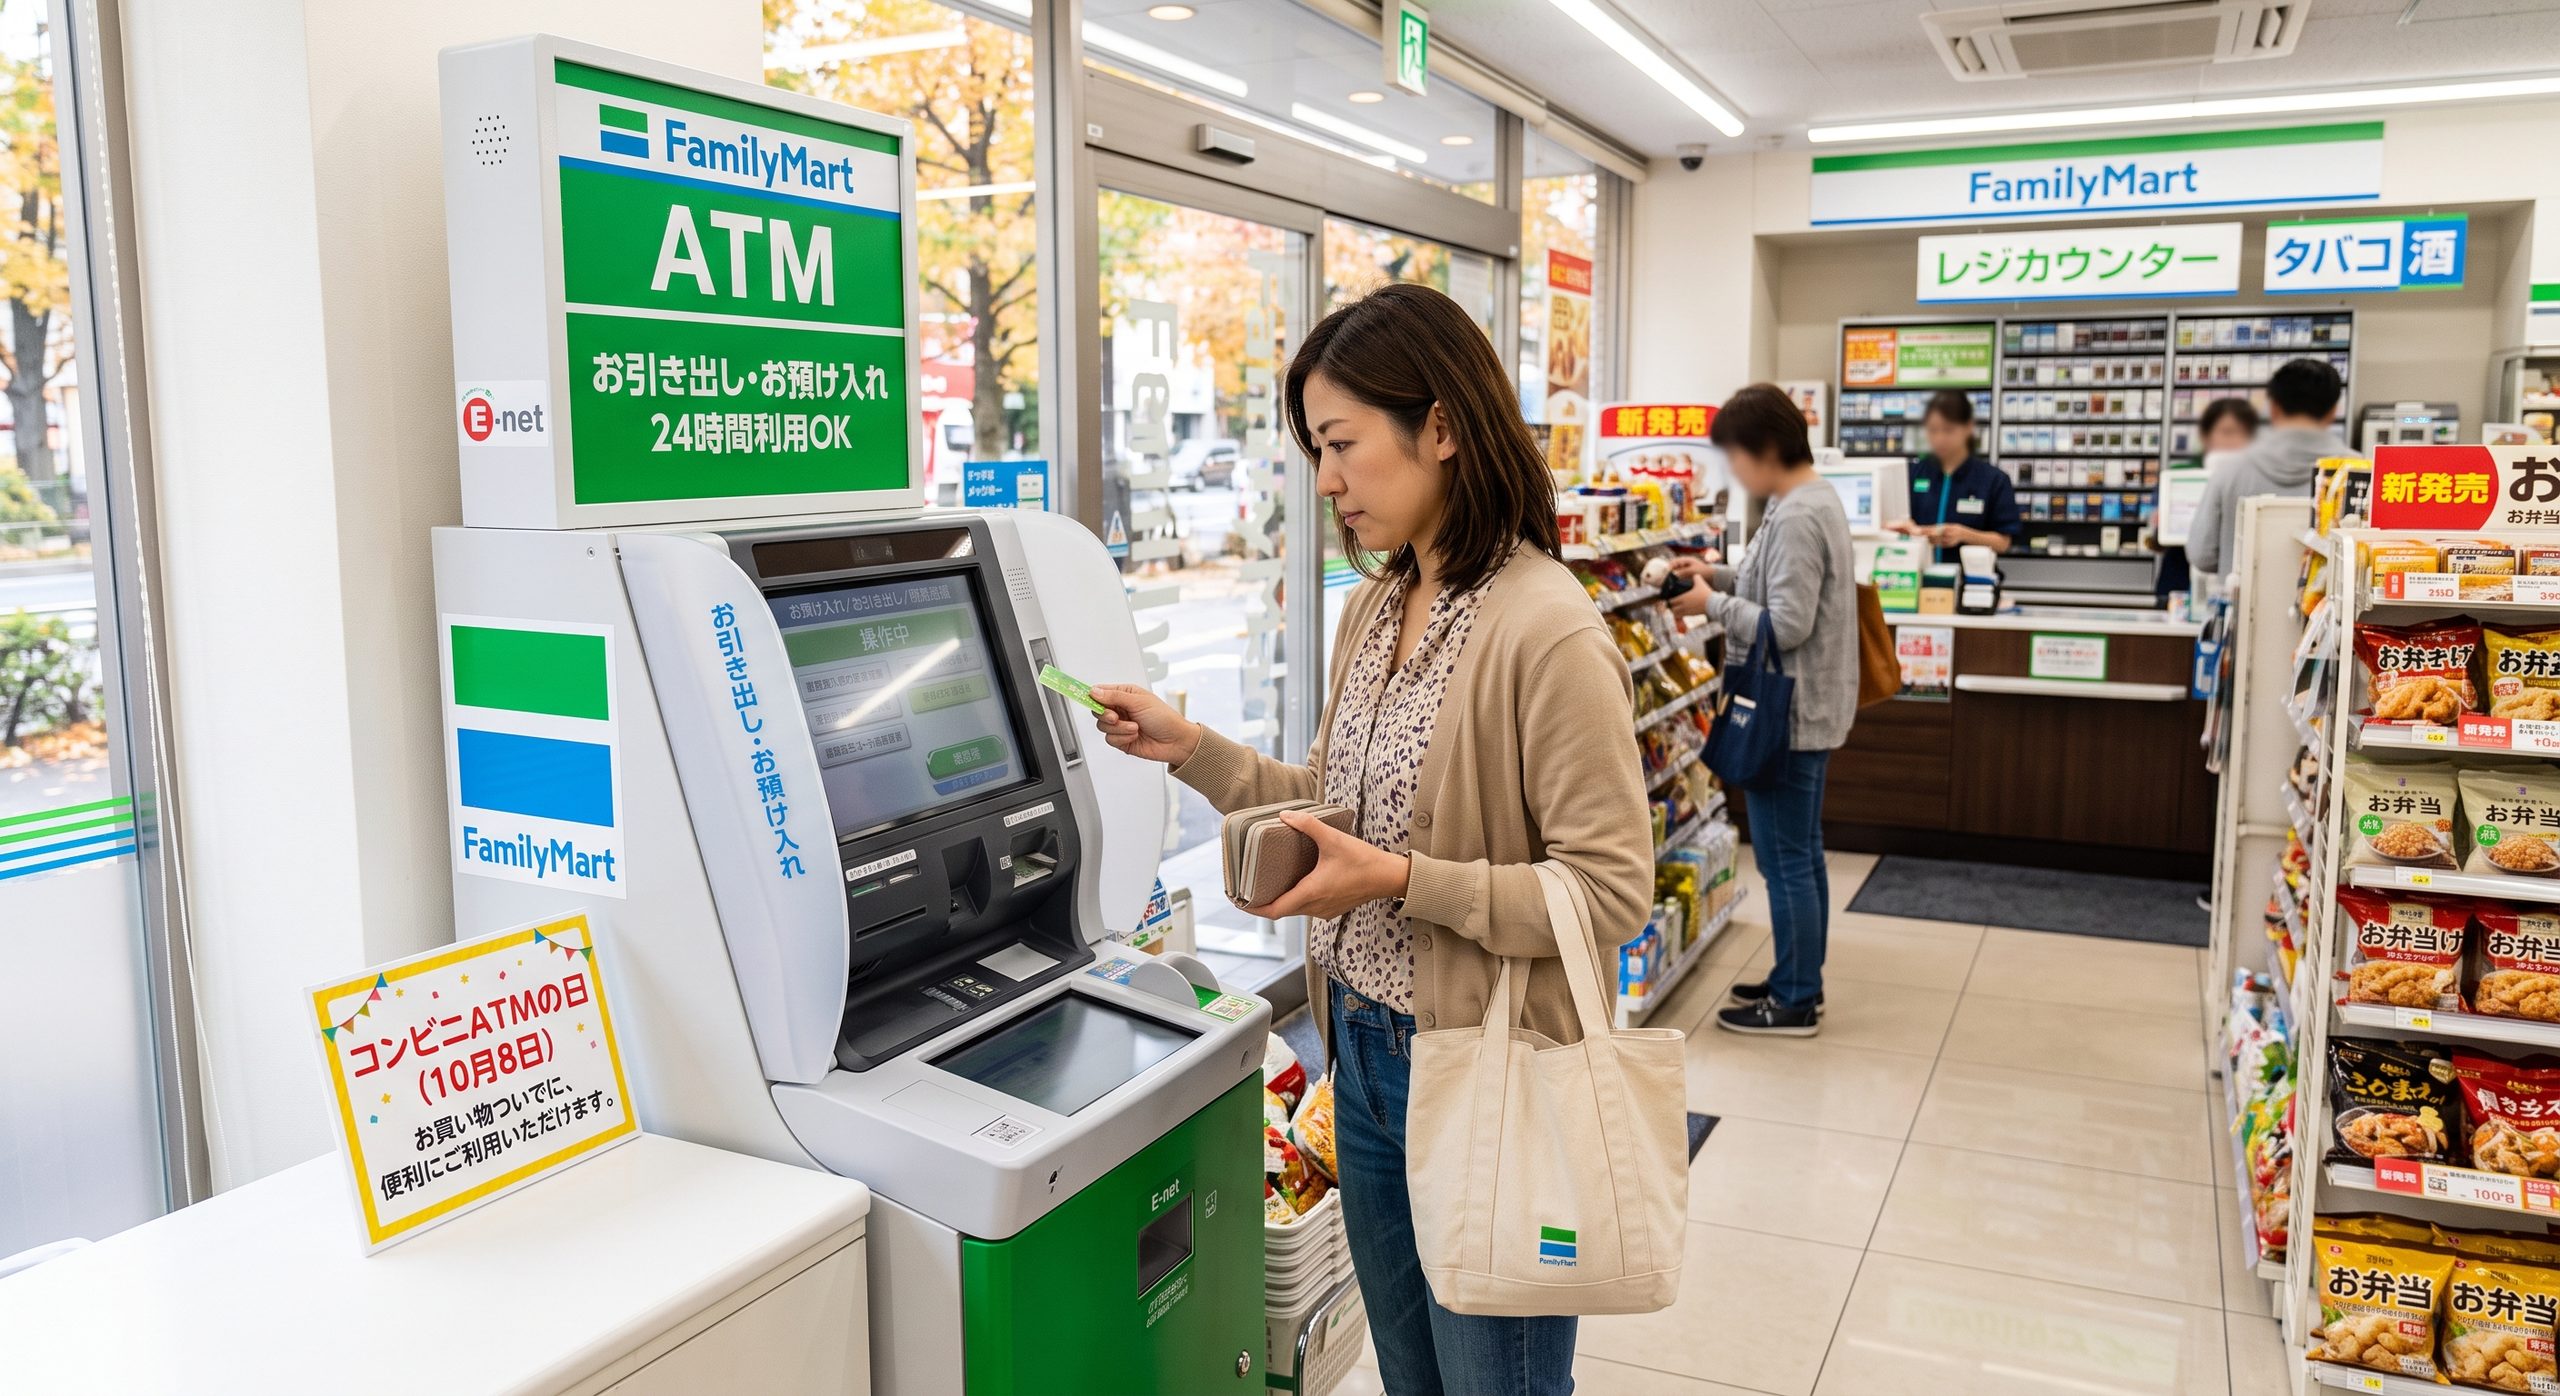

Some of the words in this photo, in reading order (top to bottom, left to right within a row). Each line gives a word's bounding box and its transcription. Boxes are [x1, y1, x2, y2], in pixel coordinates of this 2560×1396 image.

[665, 118, 854, 194] FamilyMart
[1968, 162, 2199, 206] FamilyMart
[650, 204, 835, 306] ATM
[1936, 241, 2220, 286] レジカウンター
[2273, 236, 2391, 278] タバコ
[2407, 229, 2456, 277] 酒
[592, 352, 889, 401] お引き出し・お預け入れ
[650, 412, 853, 454] 24時間利用OK
[1616, 406, 1707, 437] 新発売
[2380, 471, 2491, 504] 新発売
[2507, 509, 2560, 525] お弁当
[859, 624, 910, 652] 操作中
[710, 602, 805, 879] お引き出し・お預け入れ
[2368, 794, 2441, 815] お弁当
[2485, 804, 2560, 827] お弁当
[463, 825, 616, 882] FamilyMart
[349, 972, 589, 1078] コンビニATMの日
[418, 1027, 555, 1106] (10月8日)
[414, 1076, 574, 1151] お買い物ついでに、
[380, 1089, 614, 1202] 便利にご利用いただけます。
[1151, 1178, 1180, 1212] E-net
[2328, 1266, 2432, 1310] お弁当
[2452, 1281, 2559, 1326] お弁当
